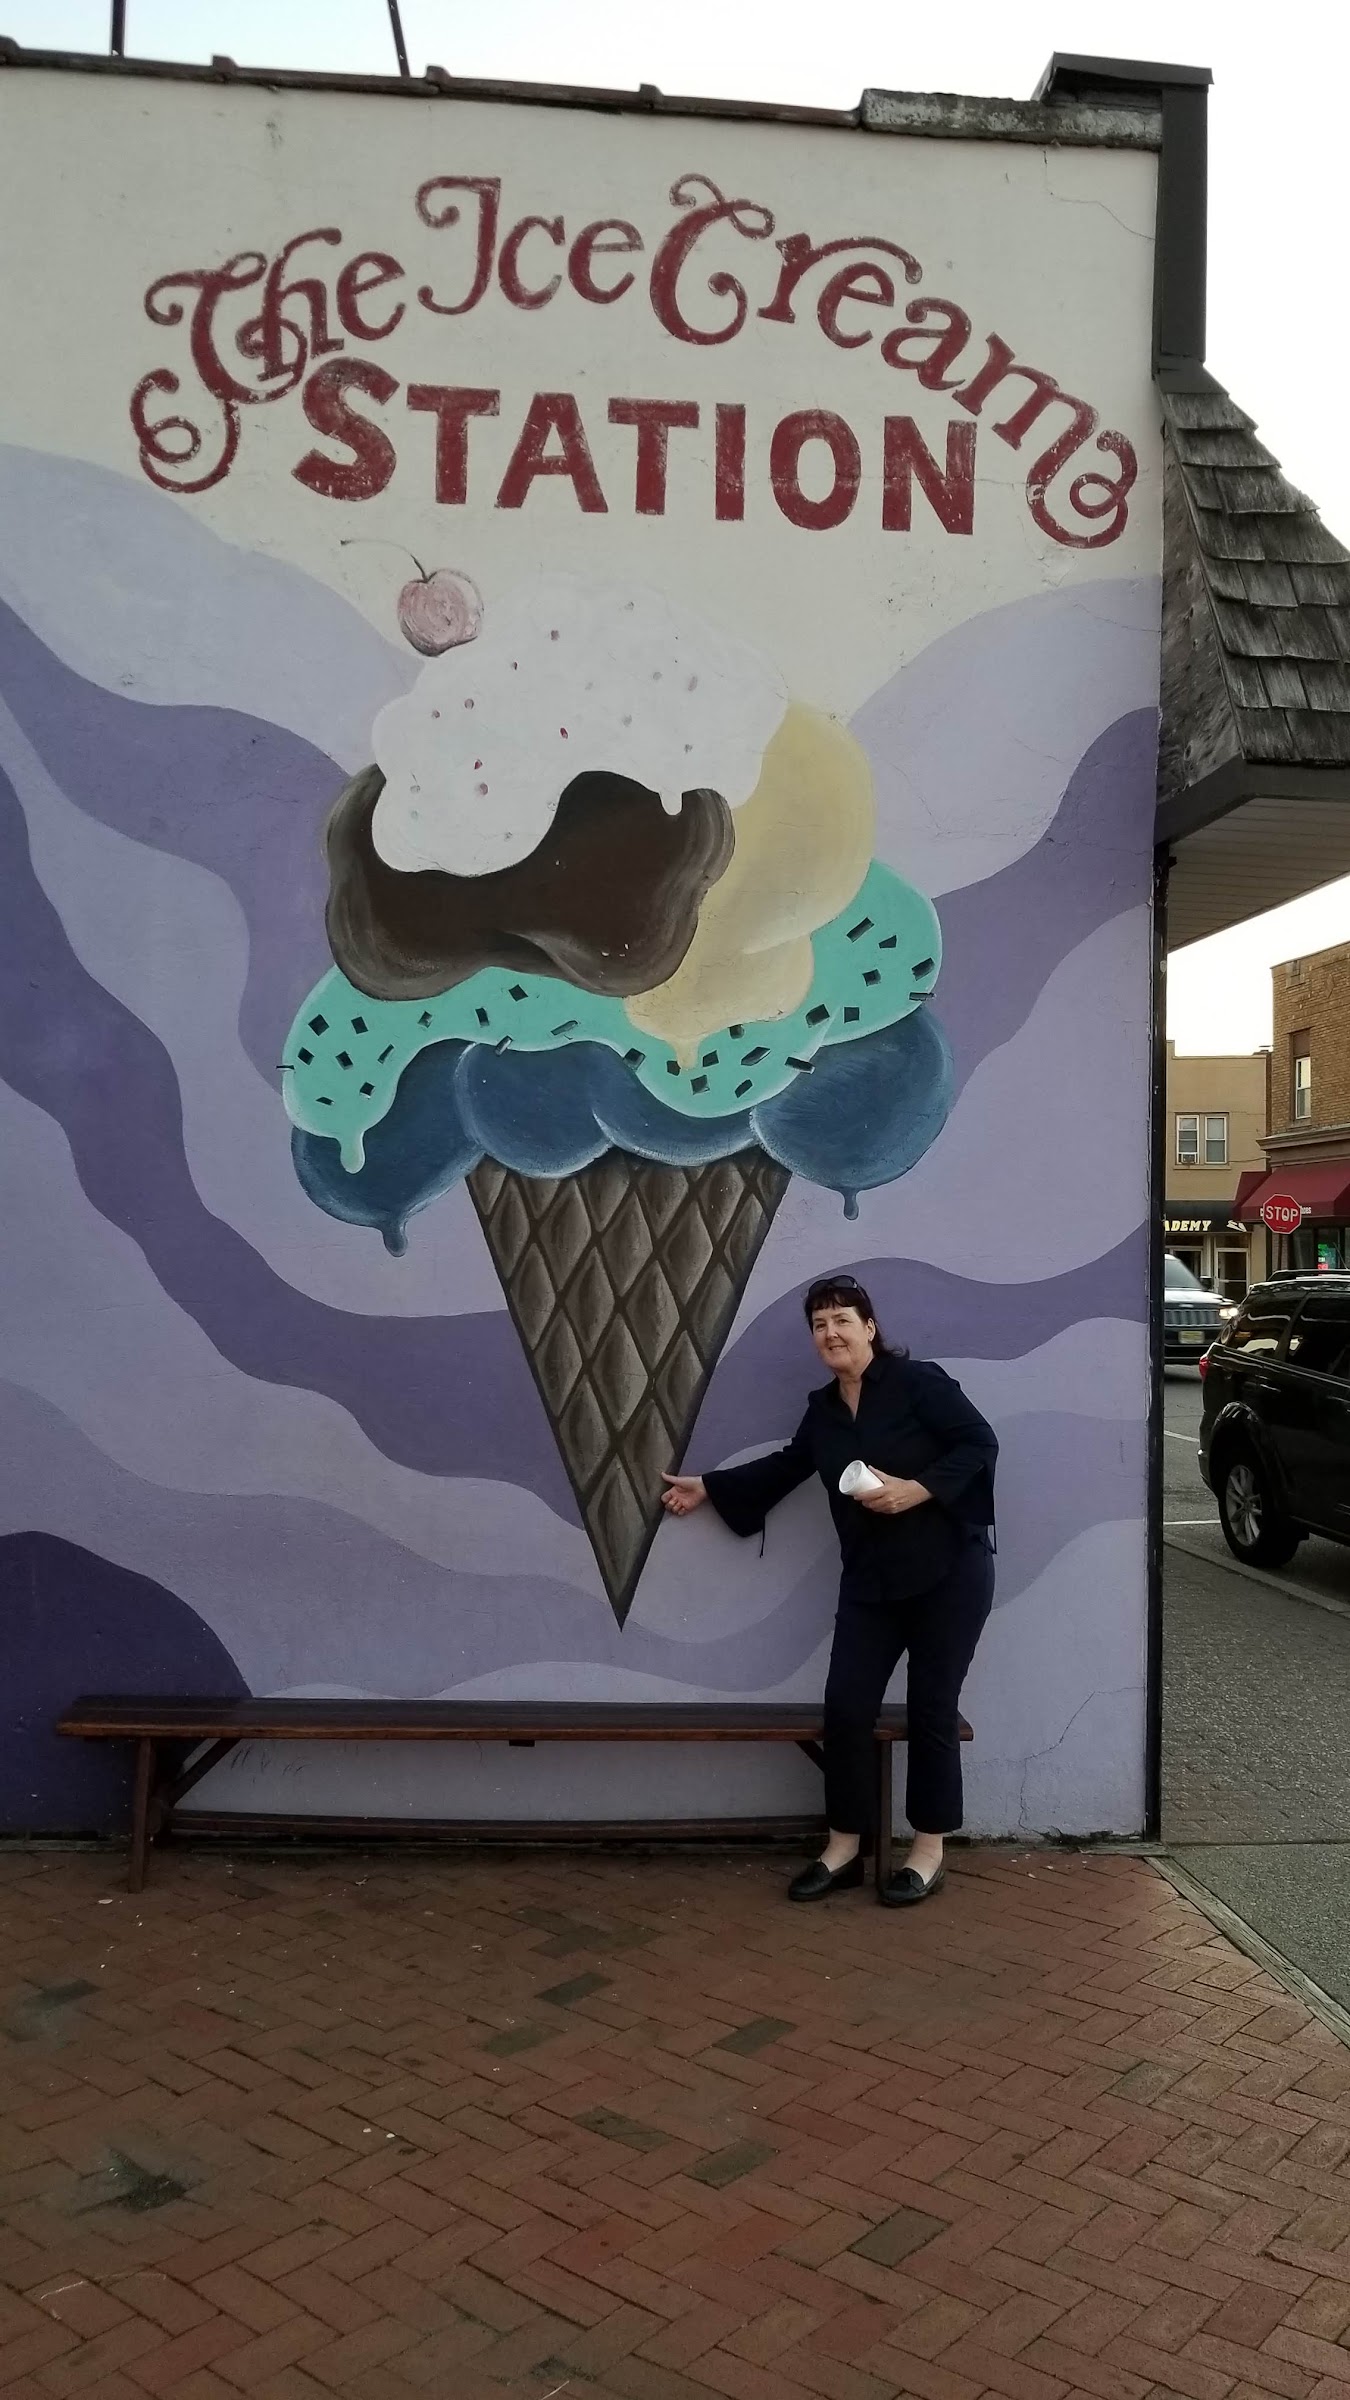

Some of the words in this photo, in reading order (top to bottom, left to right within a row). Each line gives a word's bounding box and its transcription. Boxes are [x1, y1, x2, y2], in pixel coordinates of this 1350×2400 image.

[130, 227, 405, 494] The
[415, 175, 645, 315] Ice
[649, 173, 1138, 549] Cream
[293, 357, 977, 535] STATION
[1265, 1205, 1299, 1222] STOP
